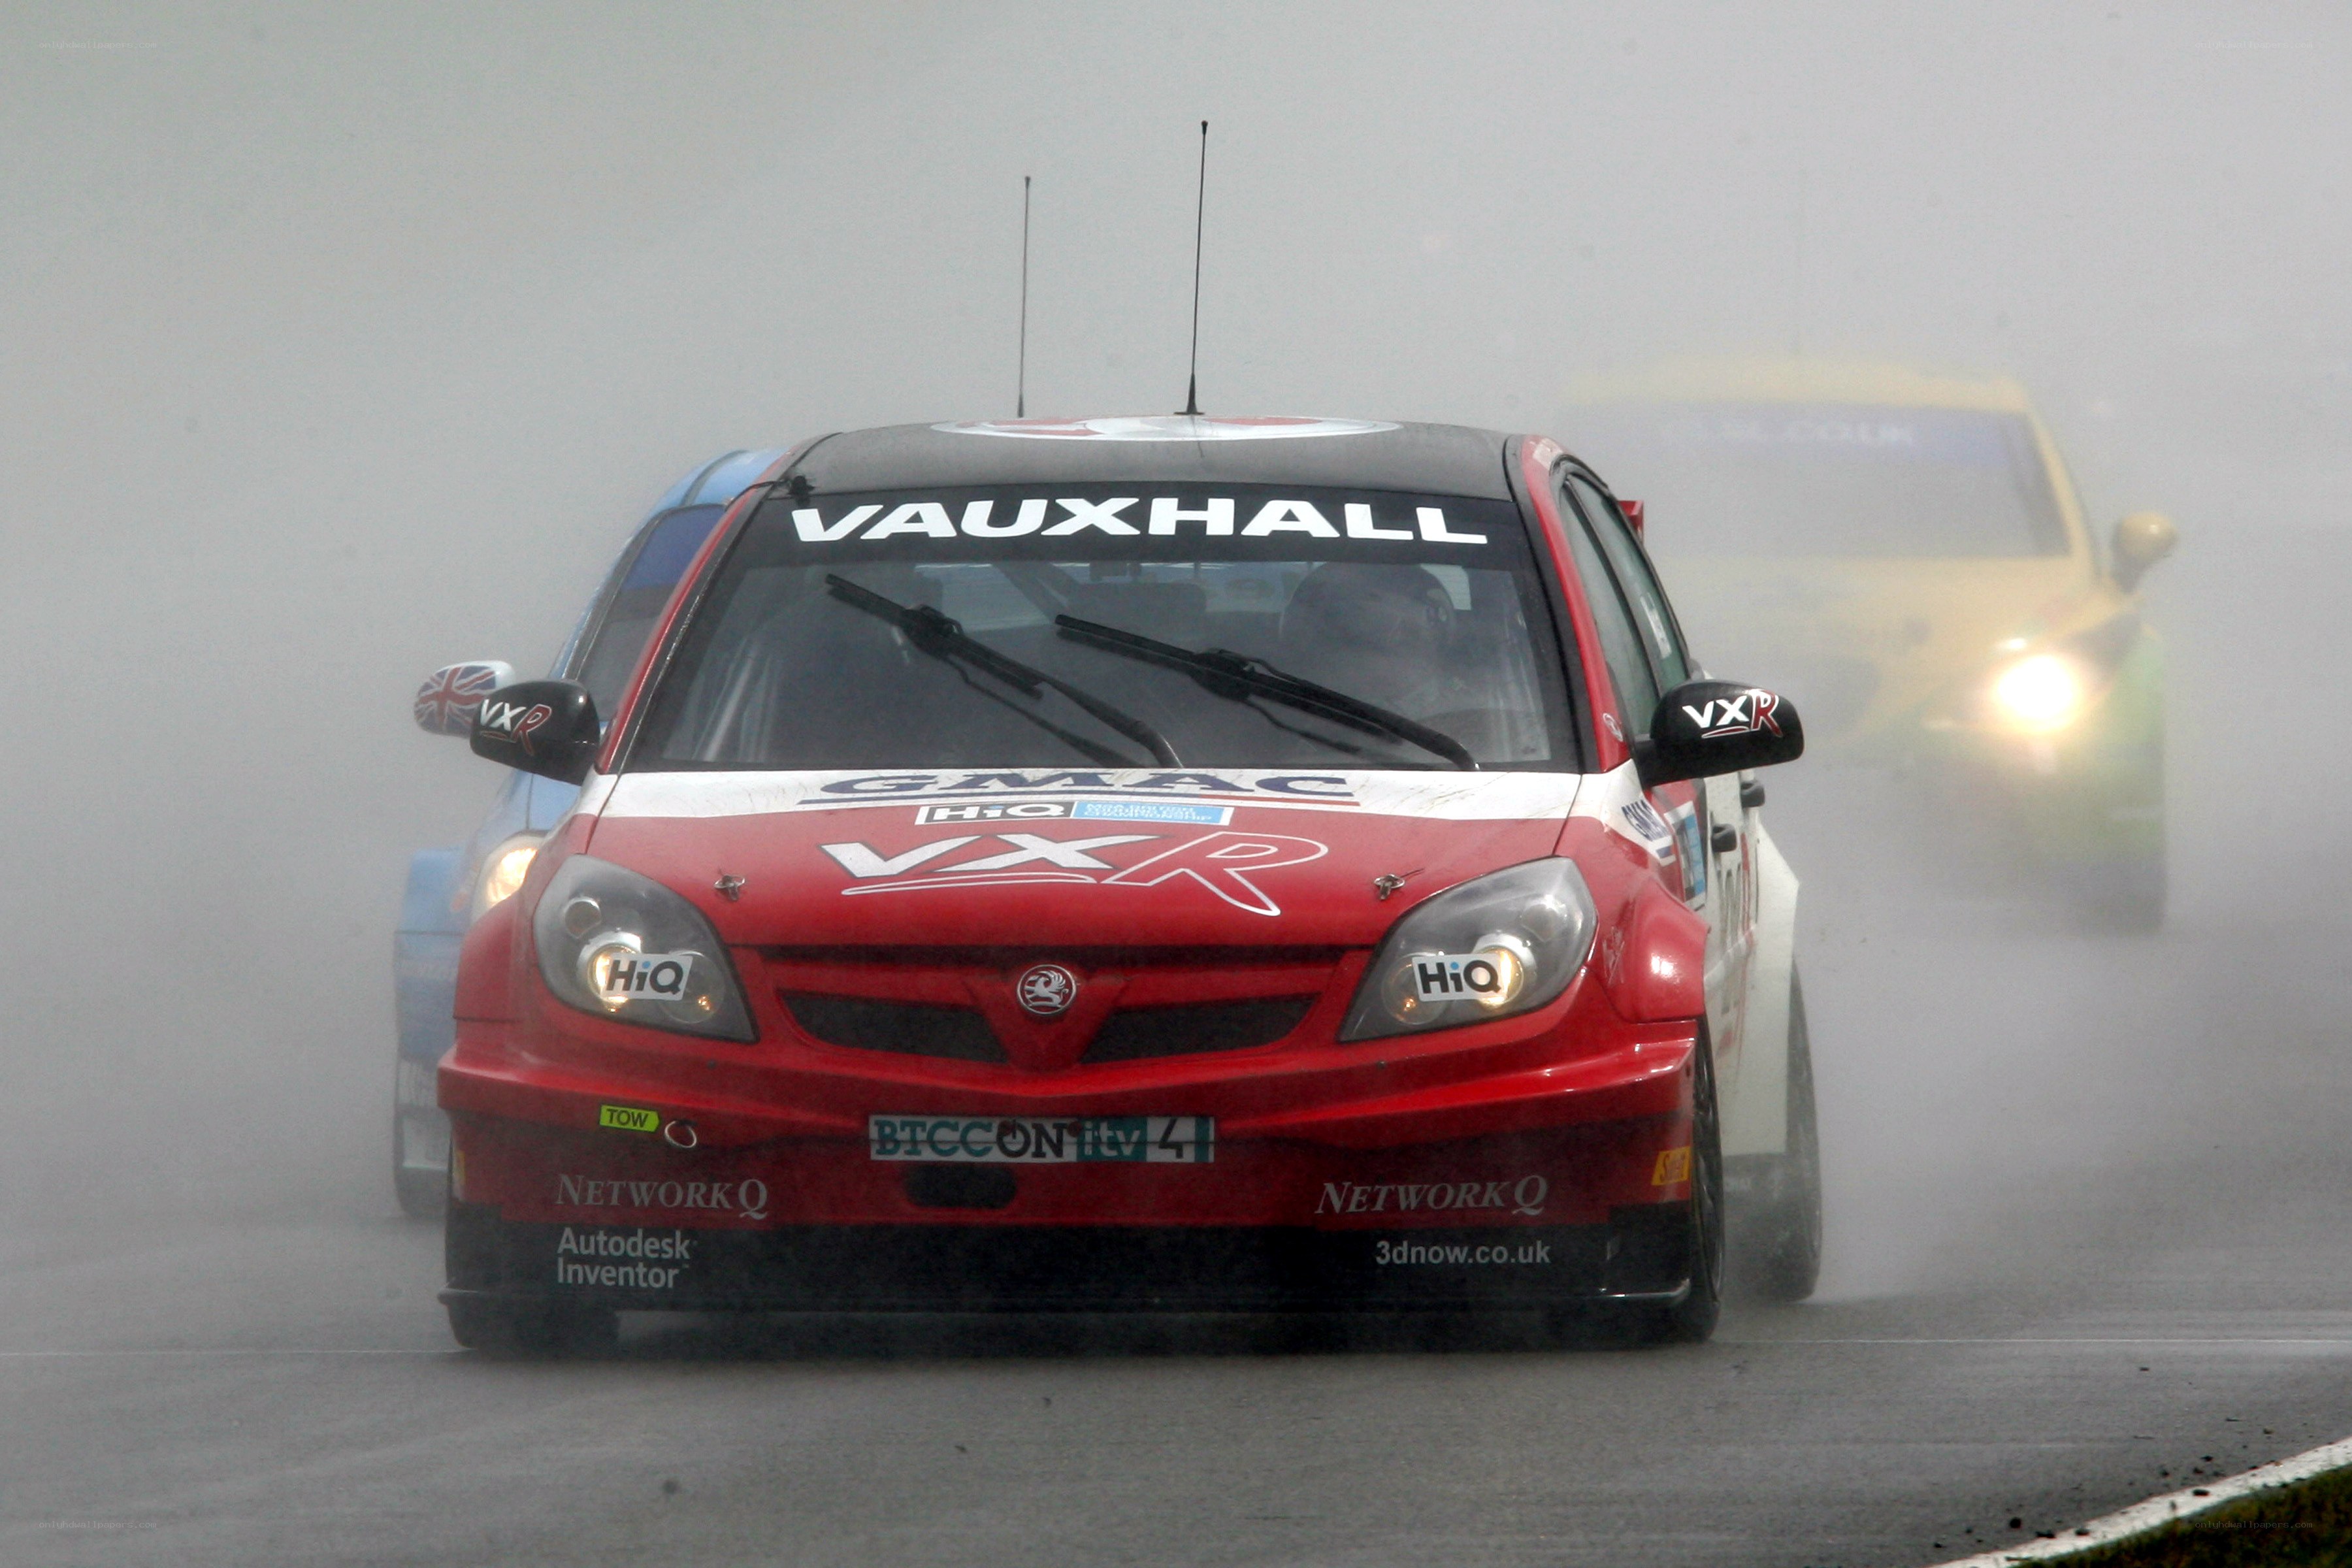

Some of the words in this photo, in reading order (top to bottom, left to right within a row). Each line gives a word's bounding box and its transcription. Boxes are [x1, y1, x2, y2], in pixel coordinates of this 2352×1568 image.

[792, 497, 1488, 544] VAUXHALL
[480, 698, 552, 757] VXR
[1682, 688, 1783, 738] VXR
[820, 772, 1354, 797] GMAC
[932, 803, 1065, 821] HiQ
[820, 830, 1329, 916] VXR
[605, 960, 684, 995] HiQ
[1418, 959, 1502, 994] HiQ
[606, 1108, 649, 1128] TOW
[557, 1226, 691, 1260] Autodesk
[1375, 1240, 1551, 1266] 3dnow.co.uk
[557, 1256, 680, 1289] Inventor
